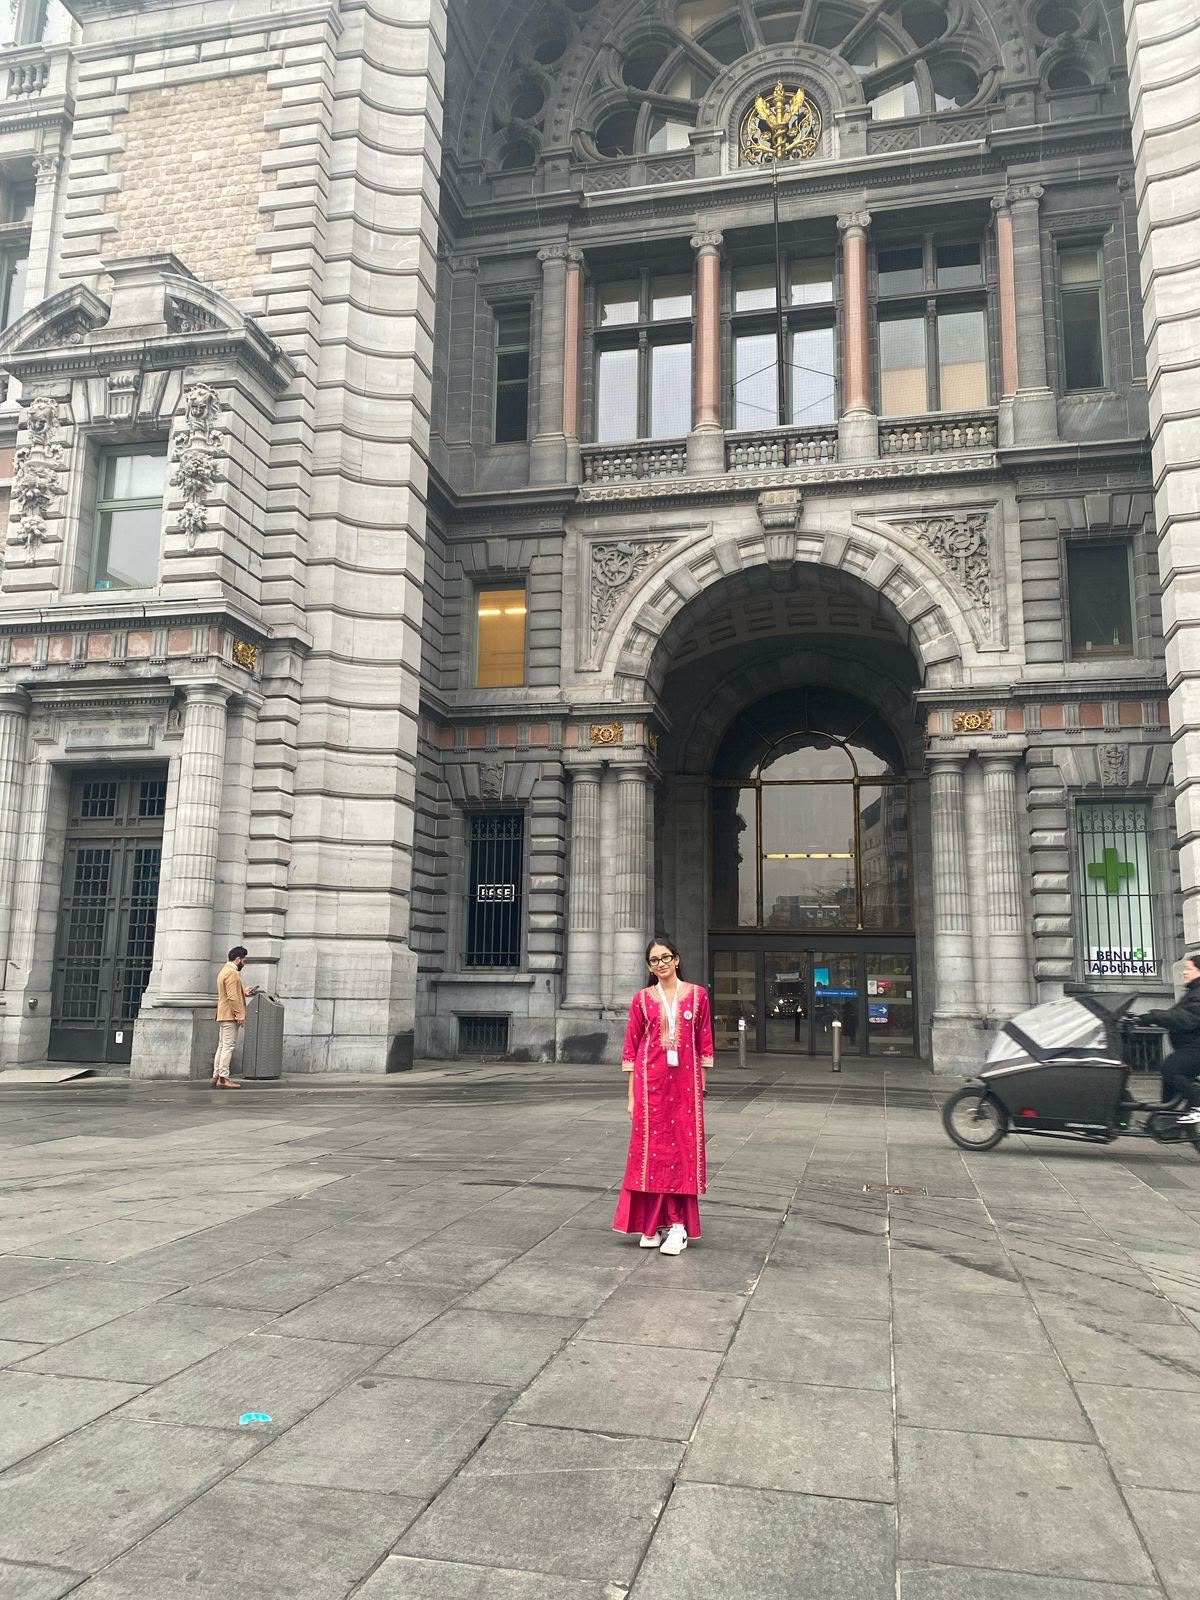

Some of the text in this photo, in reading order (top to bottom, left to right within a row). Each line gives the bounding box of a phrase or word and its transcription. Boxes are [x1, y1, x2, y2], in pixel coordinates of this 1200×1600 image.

[481, 888, 511, 898] BASE
[1096, 950, 1133, 961] BENU
[1092, 962, 1154, 974] Apotheek
